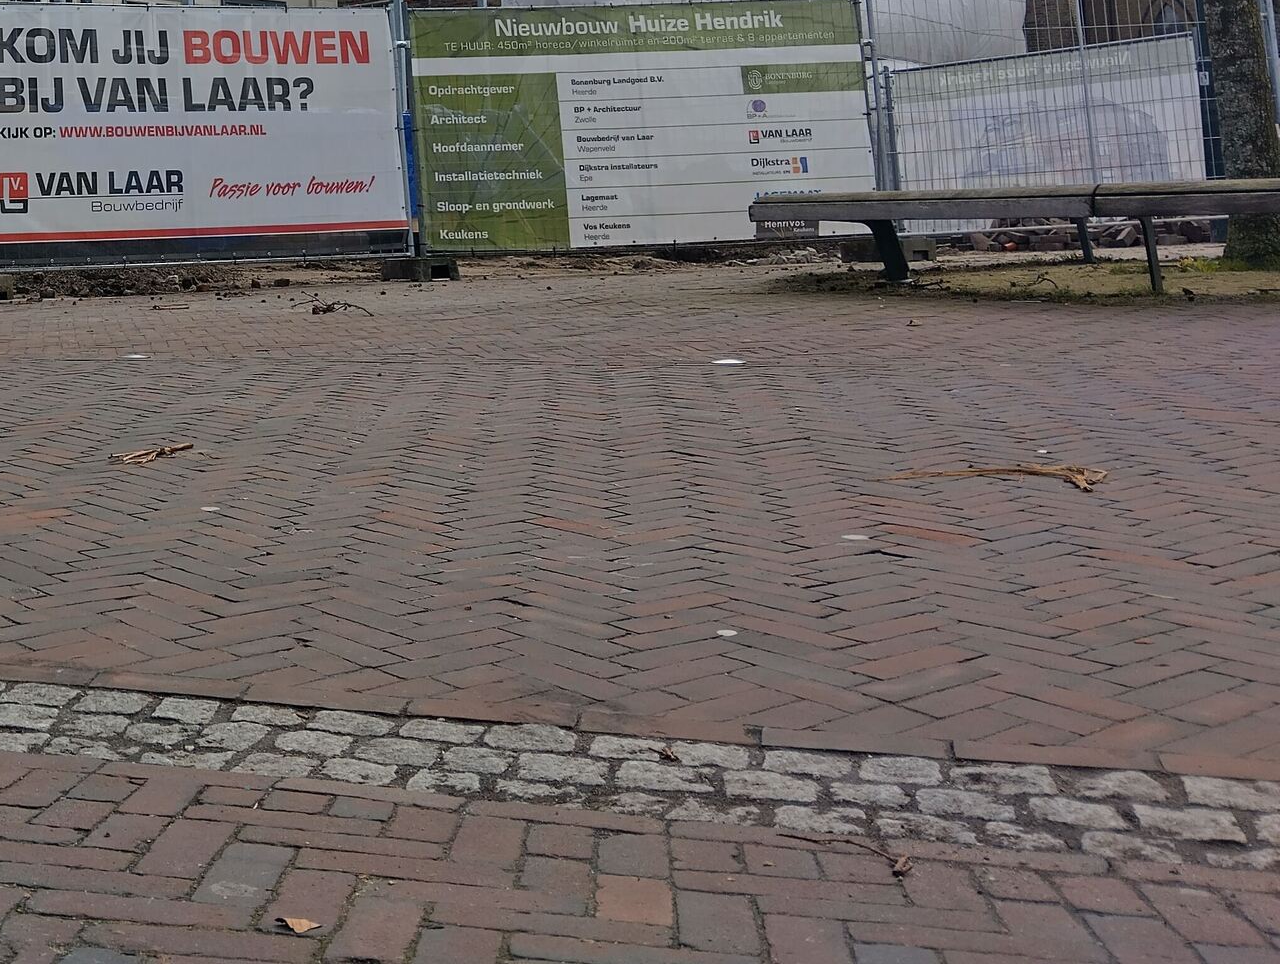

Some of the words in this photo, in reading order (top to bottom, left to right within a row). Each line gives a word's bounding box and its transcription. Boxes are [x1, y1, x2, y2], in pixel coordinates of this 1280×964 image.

[494, 17, 619, 37] Nieuwbouw
[628, 14, 690, 34] Huize
[694, 10, 784, 31] Hendrik
[444, 42, 458, 52] TE
[460, 41, 495, 52] HUUR:
[535, 37, 644, 50] horeca/winkelruimte
[700, 34, 734, 44] terras
[736, 34, 745, 42] &
[758, 31, 835, 43] appartementen
[111, 29, 170, 65] JIJ
[183, 30, 370, 65] BOUWEN
[612, 76, 648, 85] Landgoed
[764, 71, 813, 80] BONENBURG
[76, 77, 169, 113] VAN
[182, 77, 314, 112] LAAR?
[428, 85, 515, 97] Opdrachtgever
[593, 105, 642, 113] Architectuur
[430, 114, 487, 125] Architect
[574, 116, 597, 124] Zwolle
[33, 126, 56, 139] OP:
[59, 124, 267, 139] WWW.BOUWENBIJVANLAAR.NL
[760, 129, 783, 138] VAN
[785, 128, 812, 137] LAAR
[576, 134, 619, 143] Bouwbedrijf
[432, 141, 524, 153] Hoofdaannemer
[577, 145, 616, 153] Wapenveld
[579, 164, 609, 172] Dijkstra
[751, 158, 791, 168] Dijkstra
[434, 169, 543, 182] Installatietechniek
[579, 174, 593, 183] Epe
[35, 171, 98, 196] VAN
[108, 169, 184, 195] LAAR
[209, 177, 262, 200] Passie
[265, 181, 301, 197] voor
[306, 175, 376, 197] bouwen!
[581, 194, 618, 202] Lagemaat
[90, 198, 184, 213] Bouwbedrijf
[436, 200, 473, 213] Sloop-
[475, 202, 490, 211] en
[492, 199, 555, 212] grondwerk
[581, 204, 608, 212] Heerde
[583, 223, 598, 231] Vos
[599, 222, 631, 230] Keukens
[439, 229, 489, 240] Keukens
[583, 233, 610, 241] Heerde
